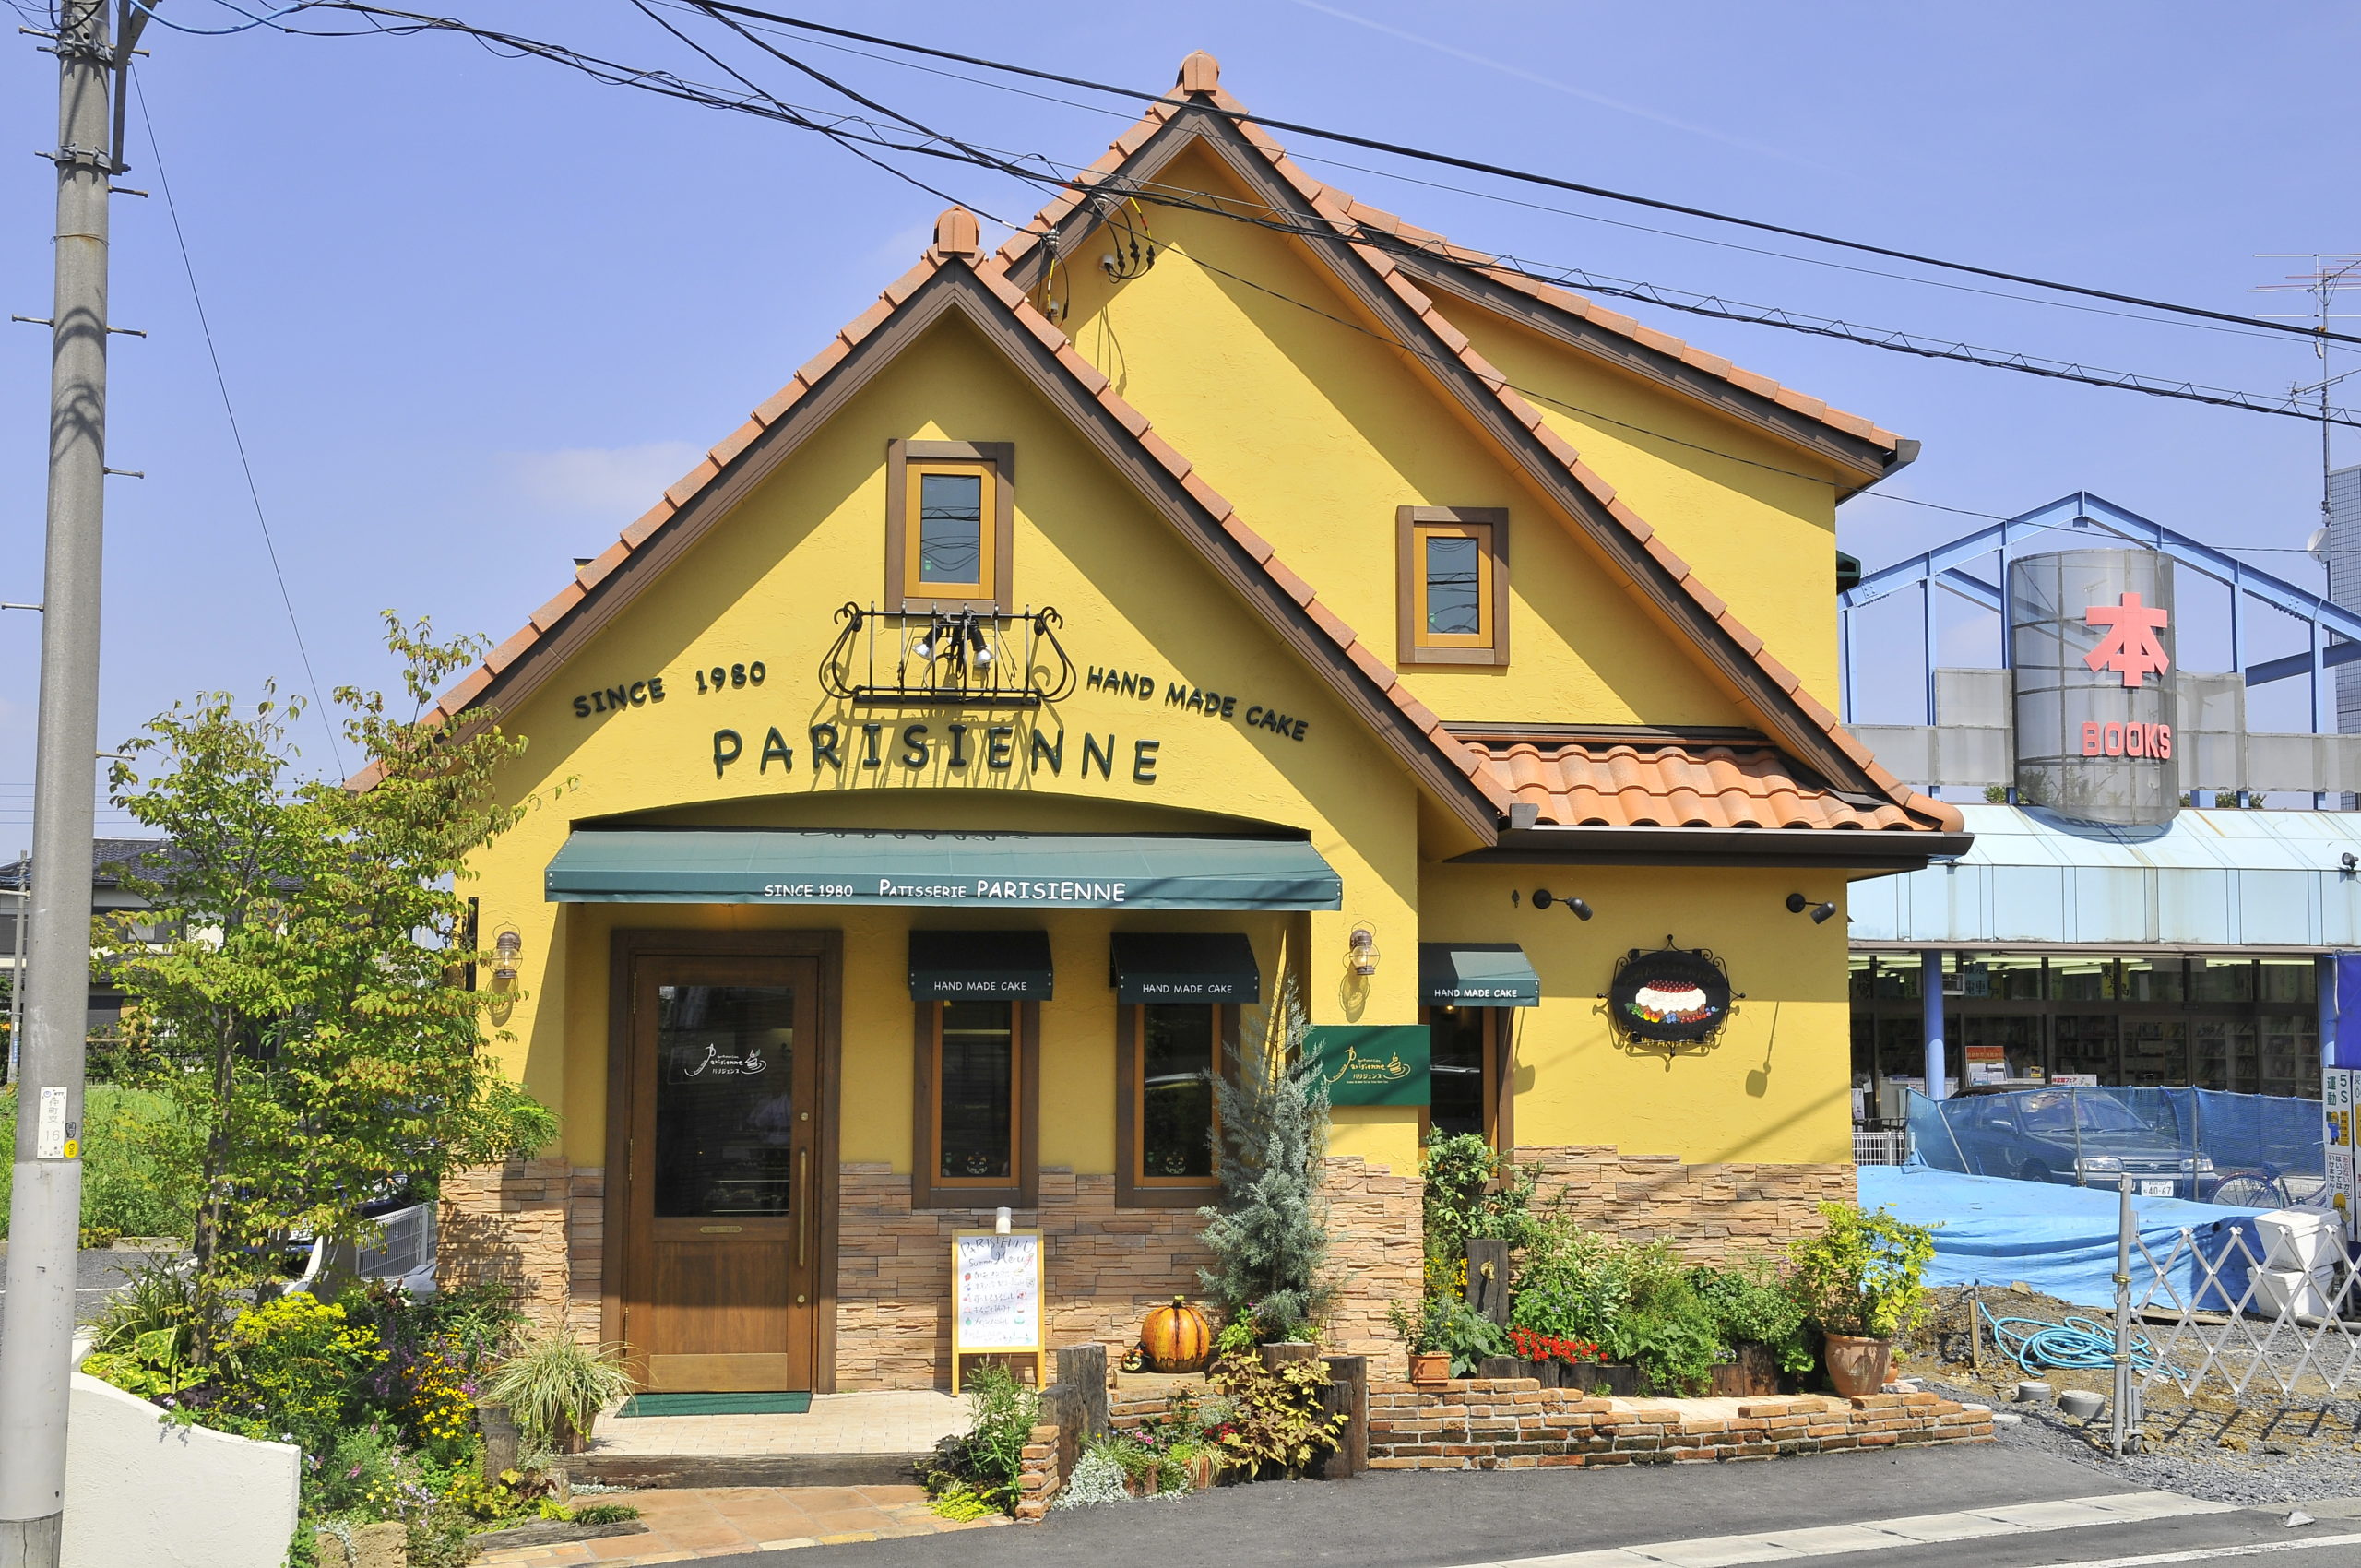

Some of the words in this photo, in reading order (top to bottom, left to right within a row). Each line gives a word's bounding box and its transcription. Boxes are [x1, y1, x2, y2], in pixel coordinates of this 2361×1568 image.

[2083, 592, 2170, 686] 本
[573, 677, 666, 718] SINCE
[695, 661, 766, 693] 1980
[1086, 665, 1155, 697] HAND
[1165, 682, 1237, 718] MADE
[1246, 705, 1309, 742] CAKE
[713, 722, 1160, 782] PARISIENNE
[2082, 721, 2171, 759] BOOKS
[764, 884, 813, 897] SINCE
[818, 885, 854, 897] 1980
[977, 880, 1126, 902] PARISIENNE
[933, 980, 963, 991] HAND
[967, 980, 996, 991] MADE
[1001, 980, 1027, 991] CAKE
[1143, 983, 1169, 993] HAND
[1173, 983, 1203, 993] MADE
[1207, 983, 1233, 993] CAKE
[1434, 989, 1460, 997] HAND
[1464, 989, 1490, 998] MADE
[1493, 989, 1517, 998] CAKE
[2327, 1075, 2337, 1106] 運動
[46, 1130, 60, 1141] 16
